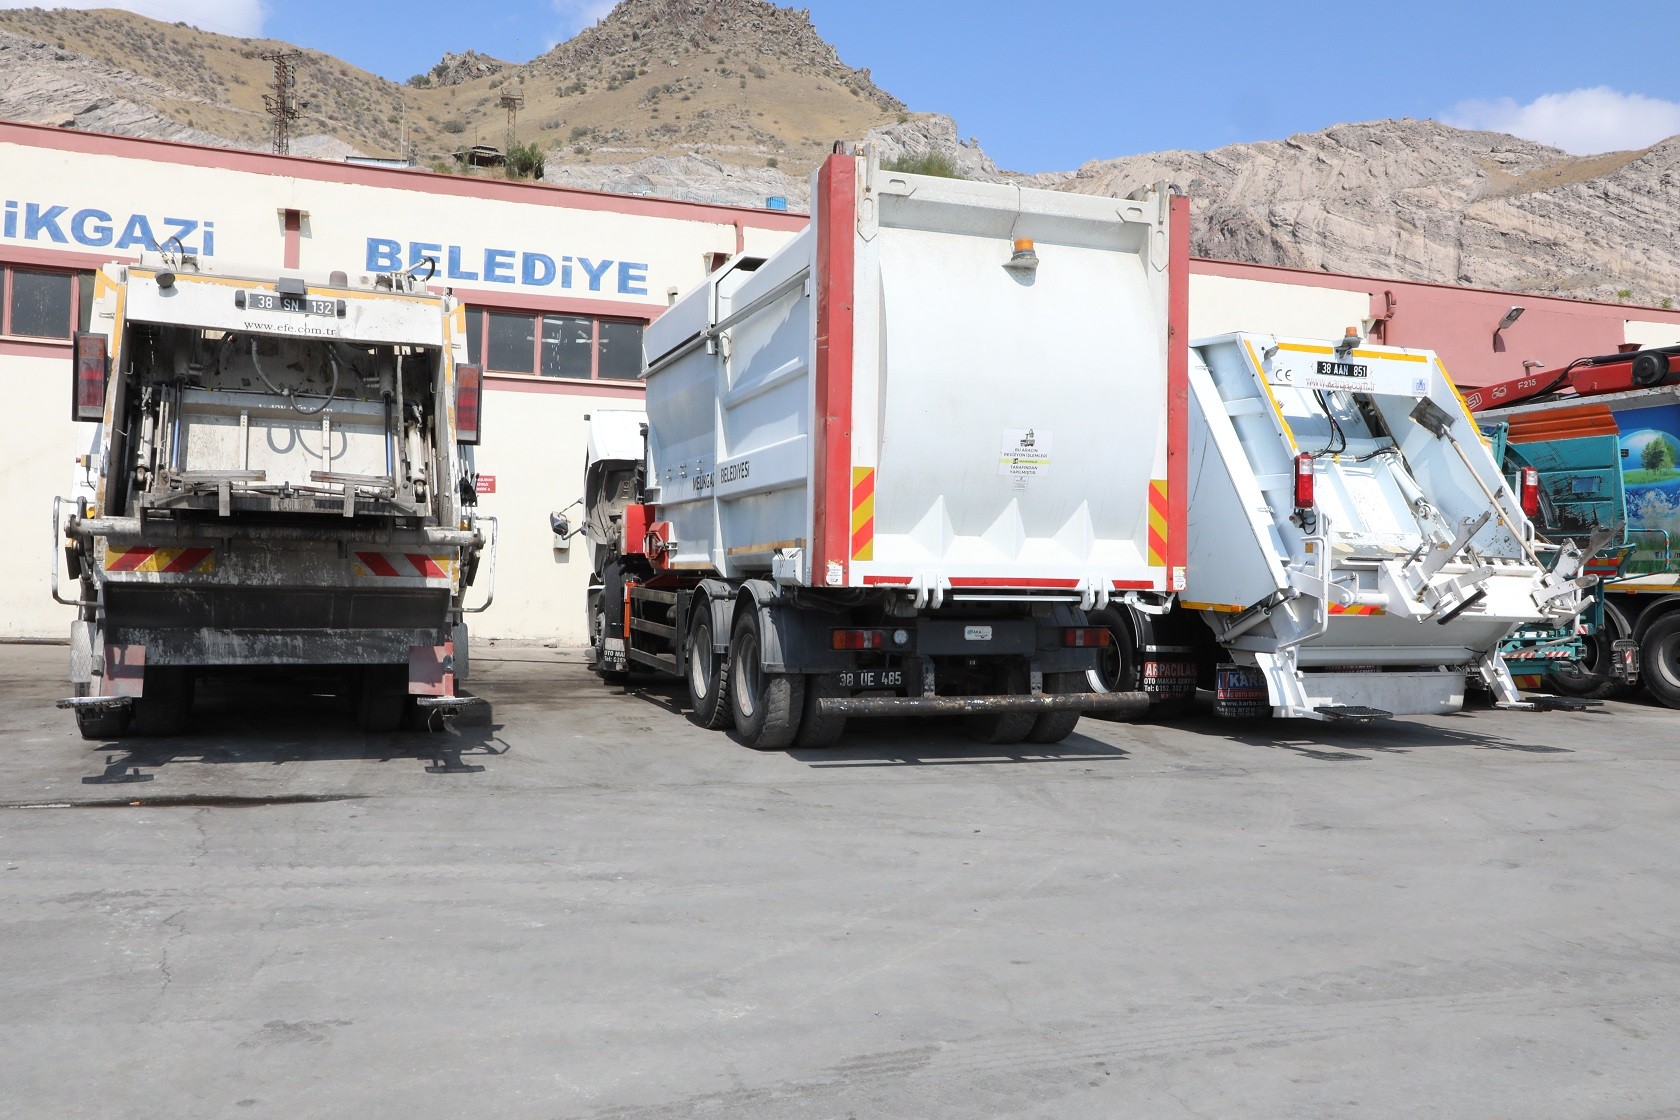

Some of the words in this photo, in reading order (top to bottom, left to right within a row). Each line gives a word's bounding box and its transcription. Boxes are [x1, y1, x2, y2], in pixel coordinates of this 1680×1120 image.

[258, 295, 273, 309] 38
[283, 298, 299, 311] SN
[312, 301, 332, 314] 132
[244, 321, 337, 336] www.efe.com.tr
[1321, 362, 1331, 374] 38
[1333, 364, 1349, 376] AAN
[1353, 366, 1367, 377] 851
[1517, 379, 1537, 390] F215
[840, 673, 854, 687] 38
[860, 672, 875, 686] UE
[881, 671, 902, 685] 485
